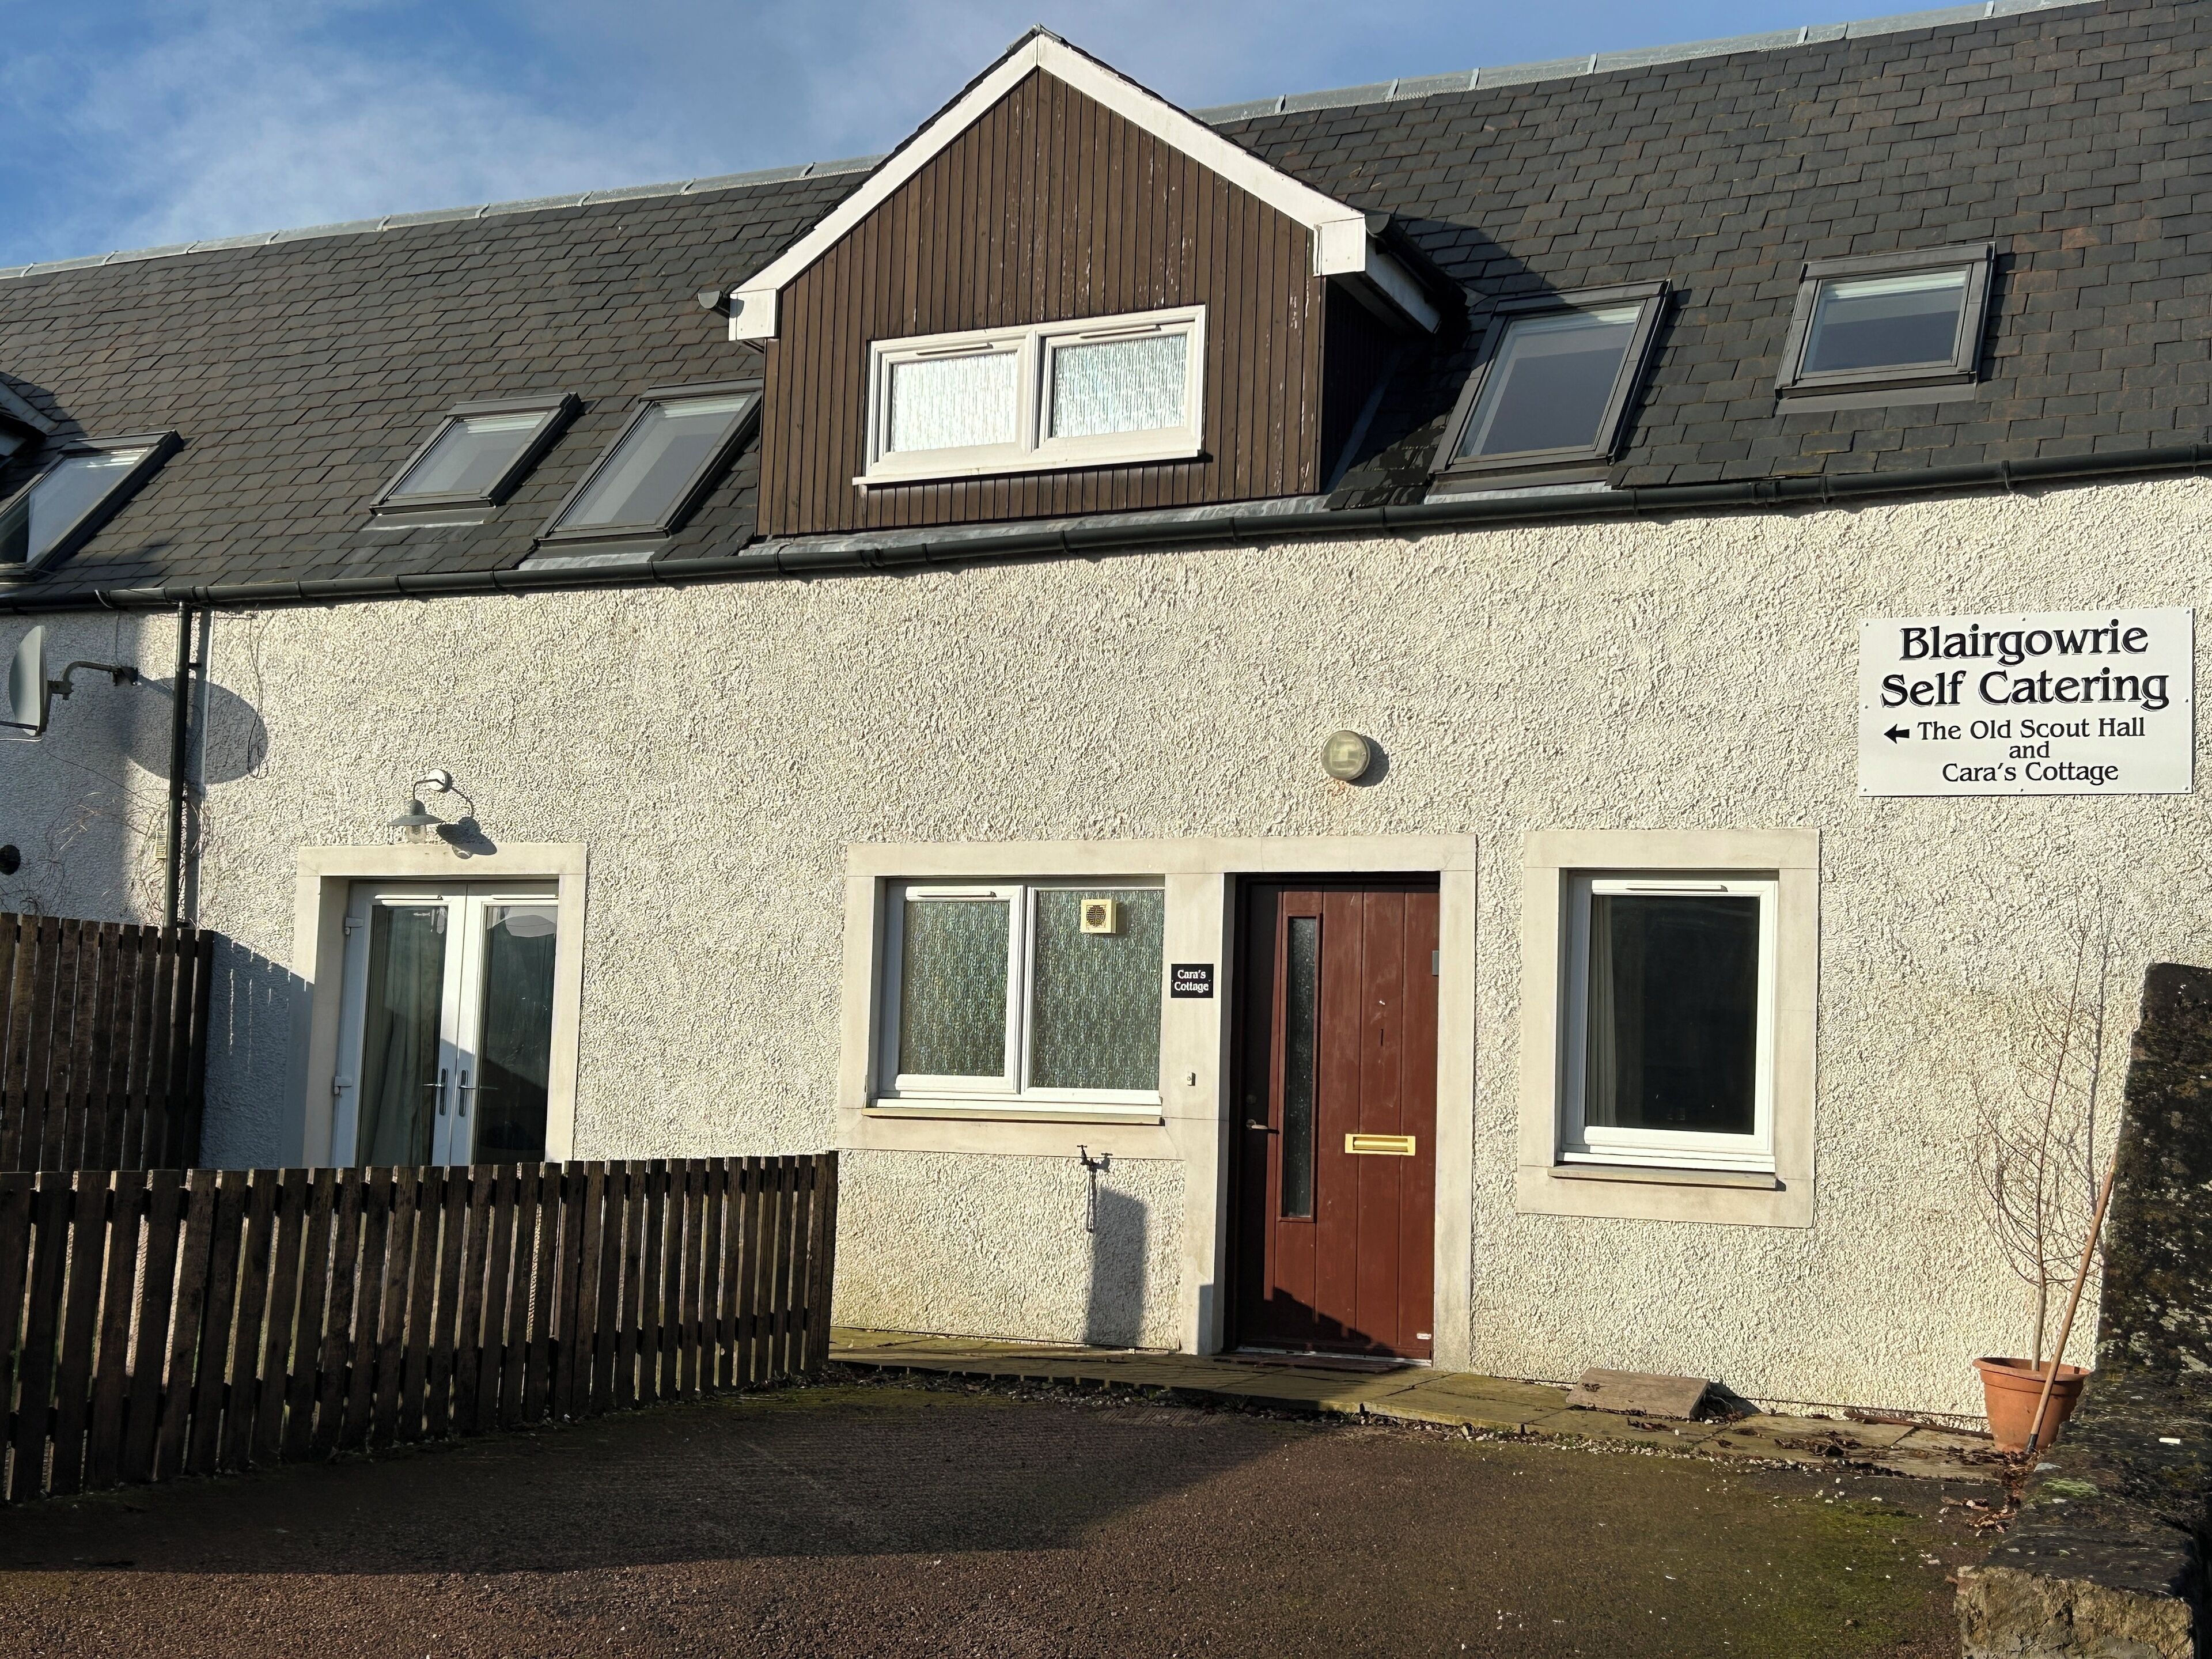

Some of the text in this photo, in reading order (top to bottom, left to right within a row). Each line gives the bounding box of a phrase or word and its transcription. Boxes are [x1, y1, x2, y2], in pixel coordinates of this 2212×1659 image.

[1900, 619, 2149, 666] Blairgowrie
[1881, 667, 2170, 711] Self Catering
[1918, 718, 2145, 740] The Old Scout Hall
[2009, 741, 2050, 759] and
[1942, 762, 2119, 785] Cara's Cottage
[1178, 969, 1206, 979] Cara's
[1175, 982, 1209, 993] Cottage
